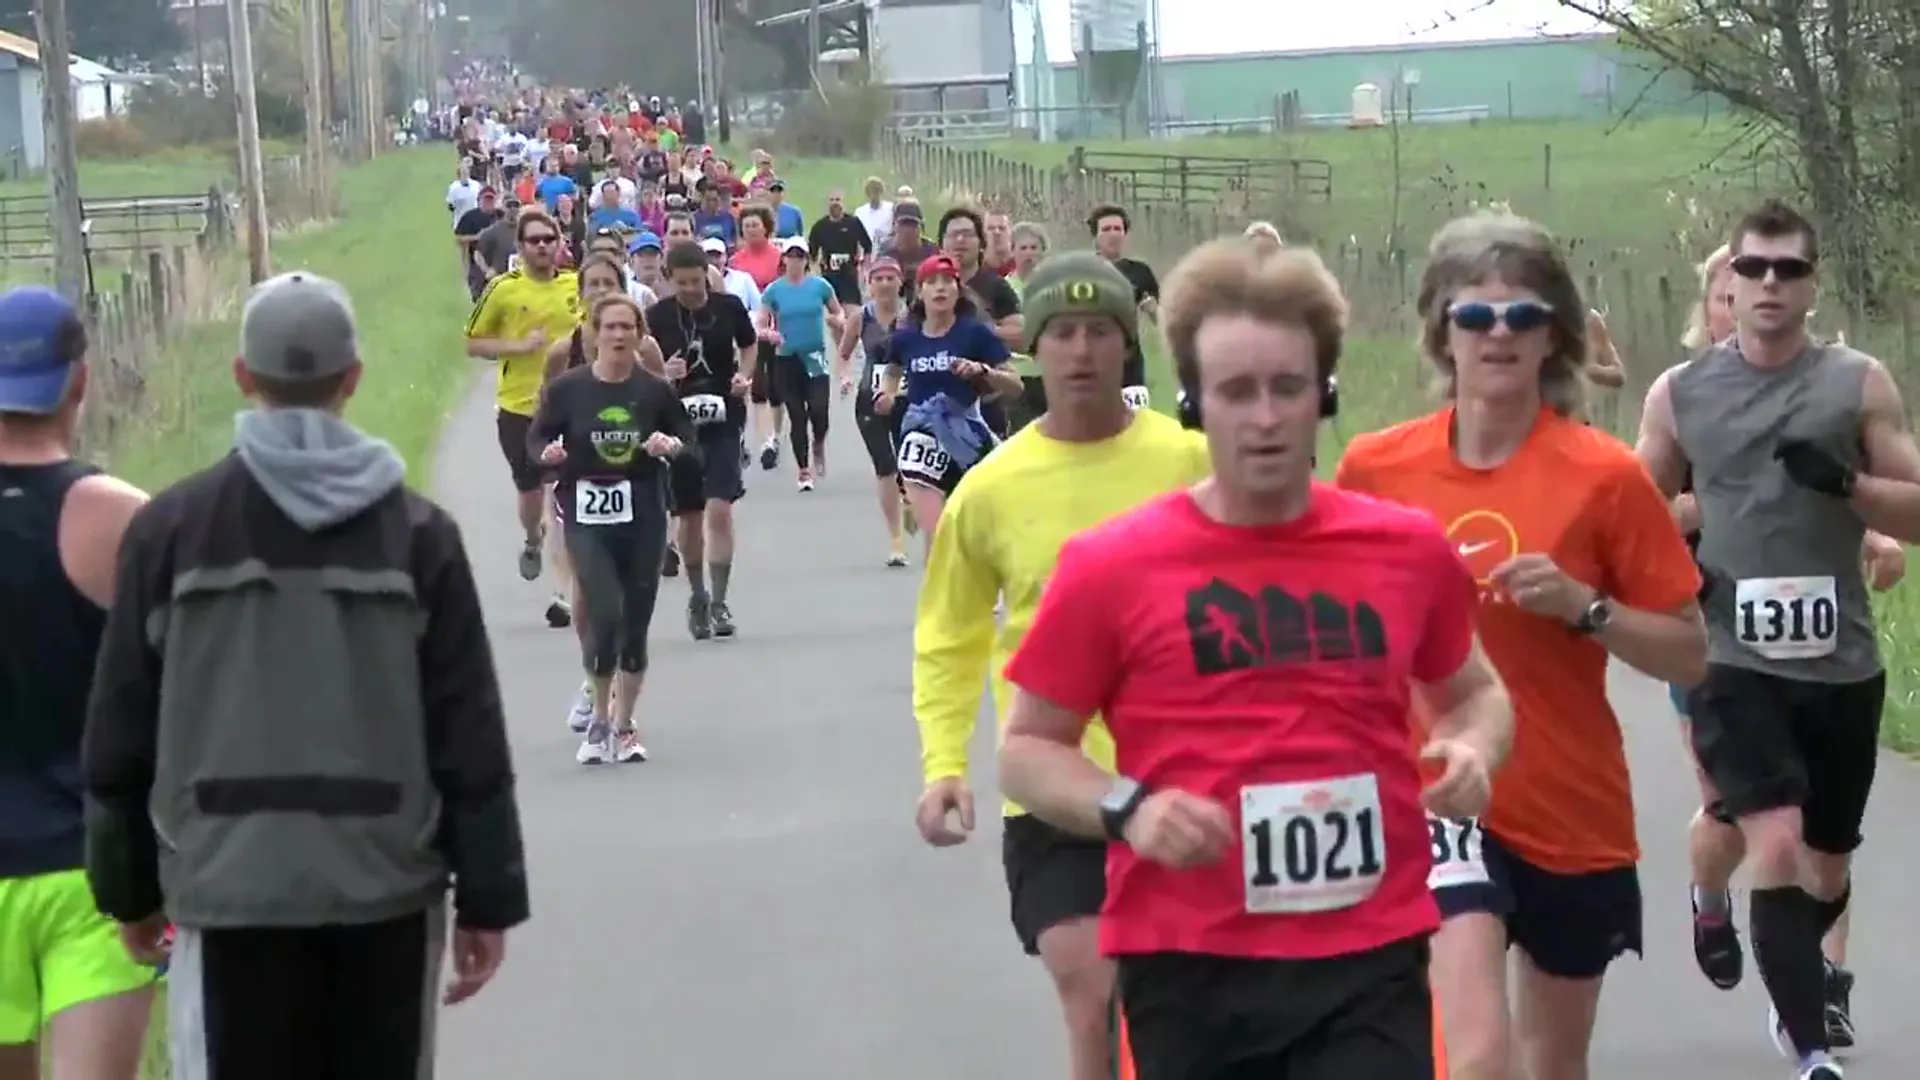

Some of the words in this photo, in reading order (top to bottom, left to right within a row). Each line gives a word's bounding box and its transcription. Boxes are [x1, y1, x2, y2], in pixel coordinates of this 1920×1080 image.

[901, 440, 951, 471] 1369
[585, 490, 624, 515] 220
[1739, 596, 1834, 643] 1310
[1249, 806, 1381, 887] 1021
